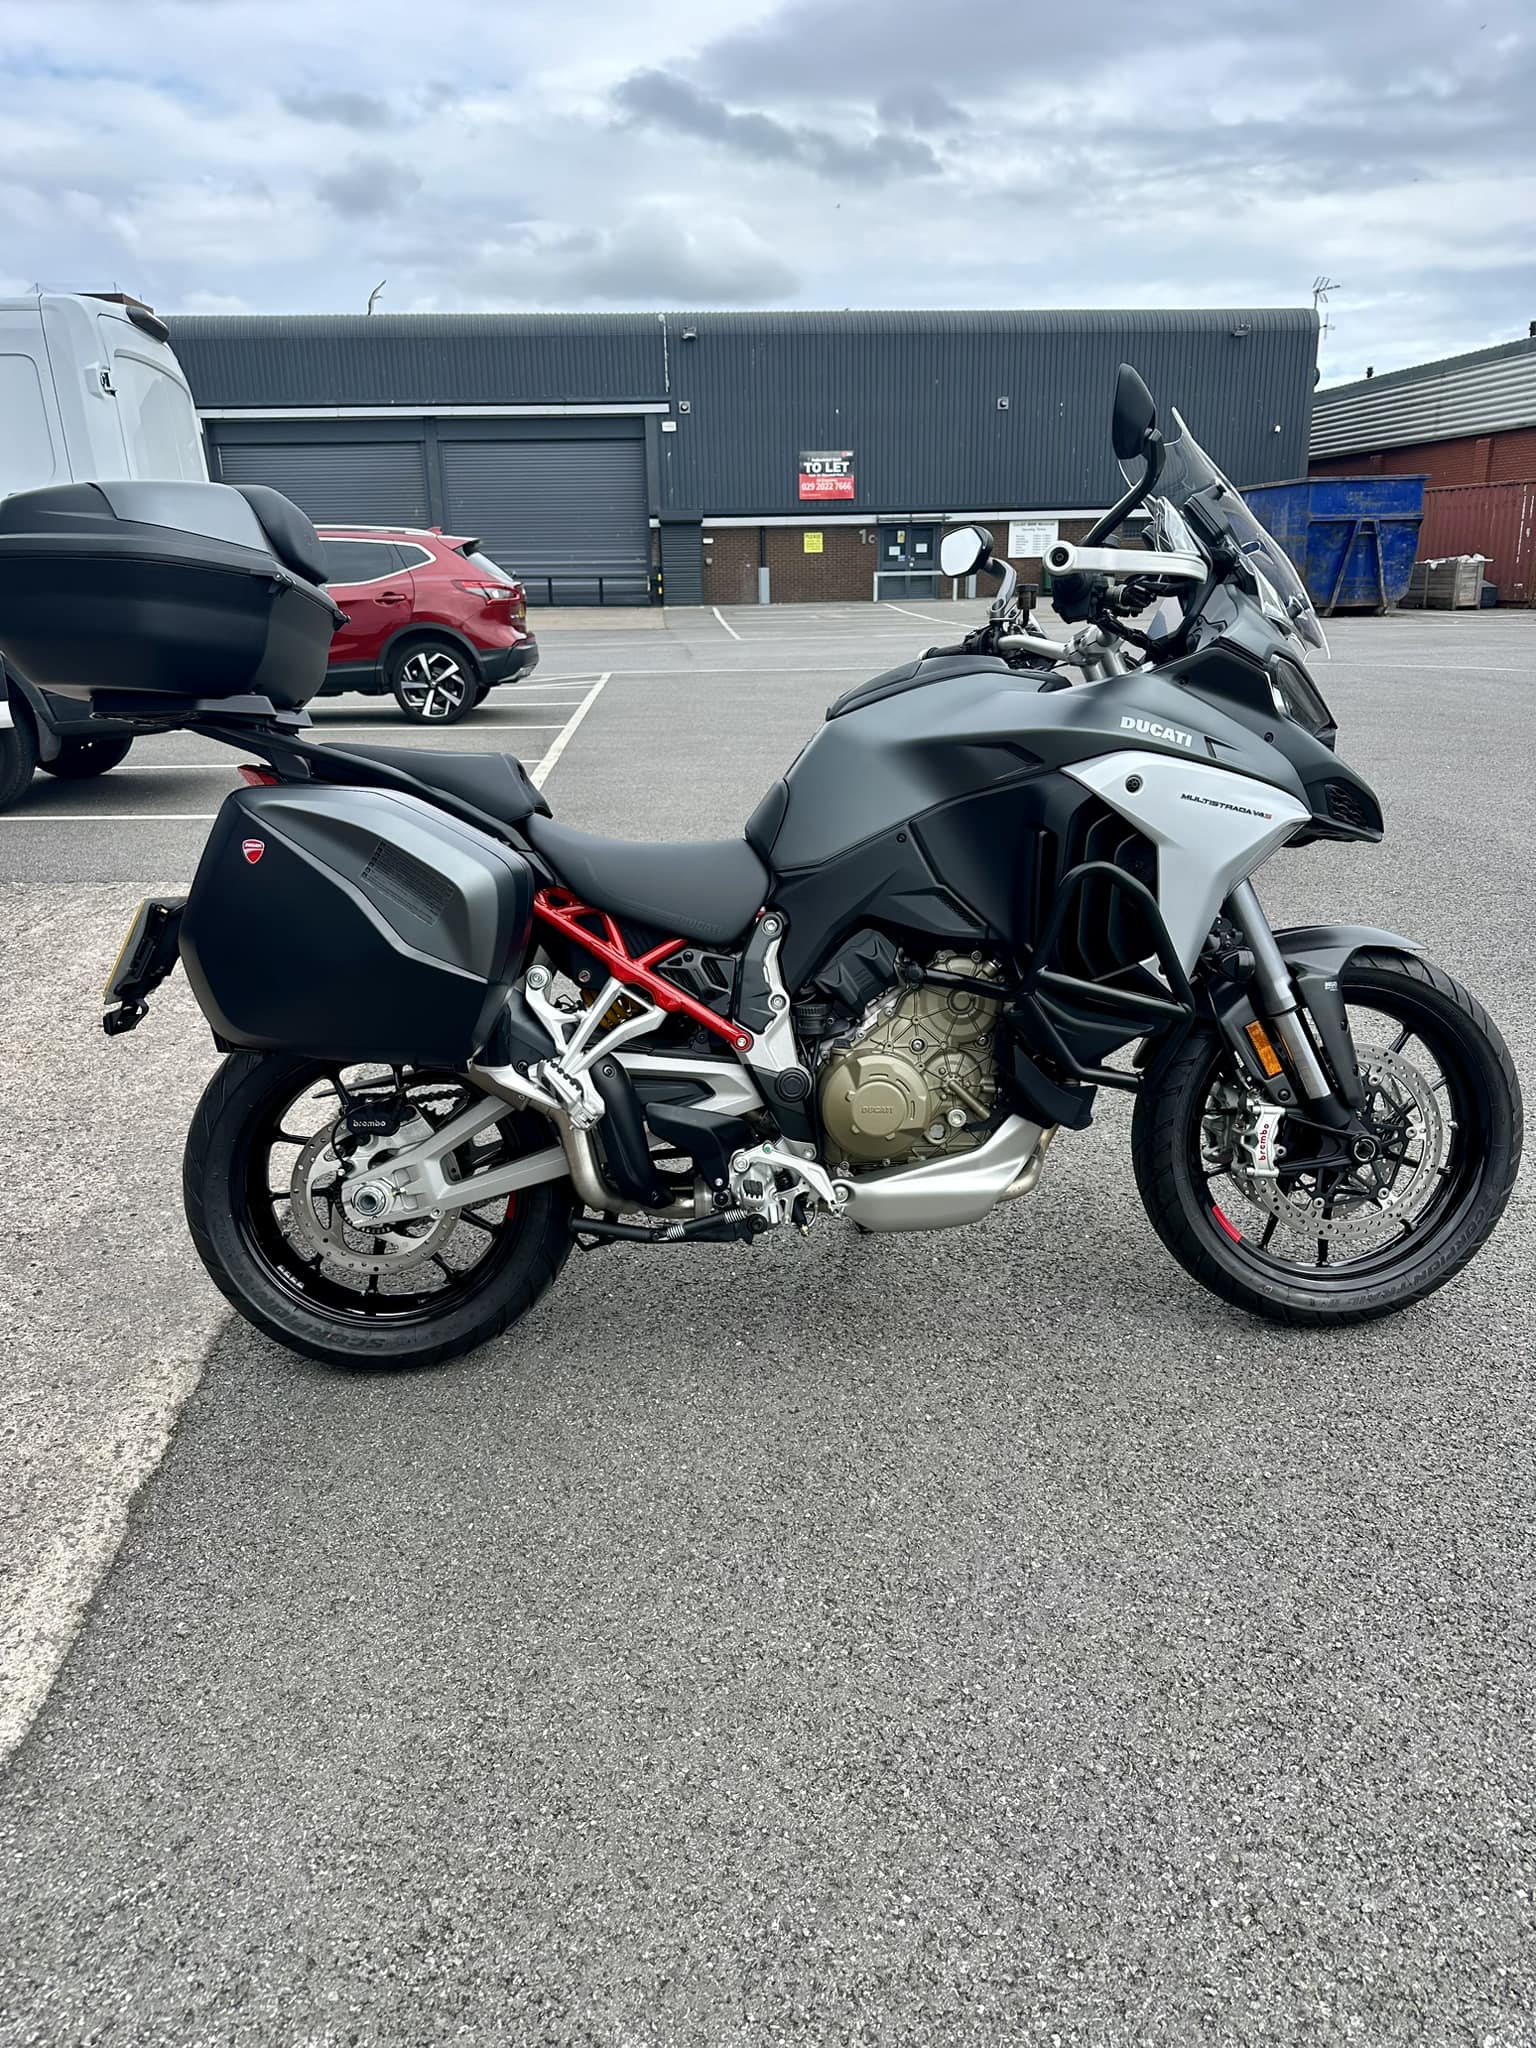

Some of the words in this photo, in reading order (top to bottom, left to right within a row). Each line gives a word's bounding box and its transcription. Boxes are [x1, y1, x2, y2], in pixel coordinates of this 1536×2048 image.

[803, 462, 822, 473] TO
[825, 462, 849, 473] LET
[801, 482, 816, 491] 029
[1120, 716, 1193, 748] DUCATI
[1180, 793, 1252, 816] MULTISTRADA
[353, 1119, 386, 1127] brembo
[1258, 1123, 1269, 1161] brembo
